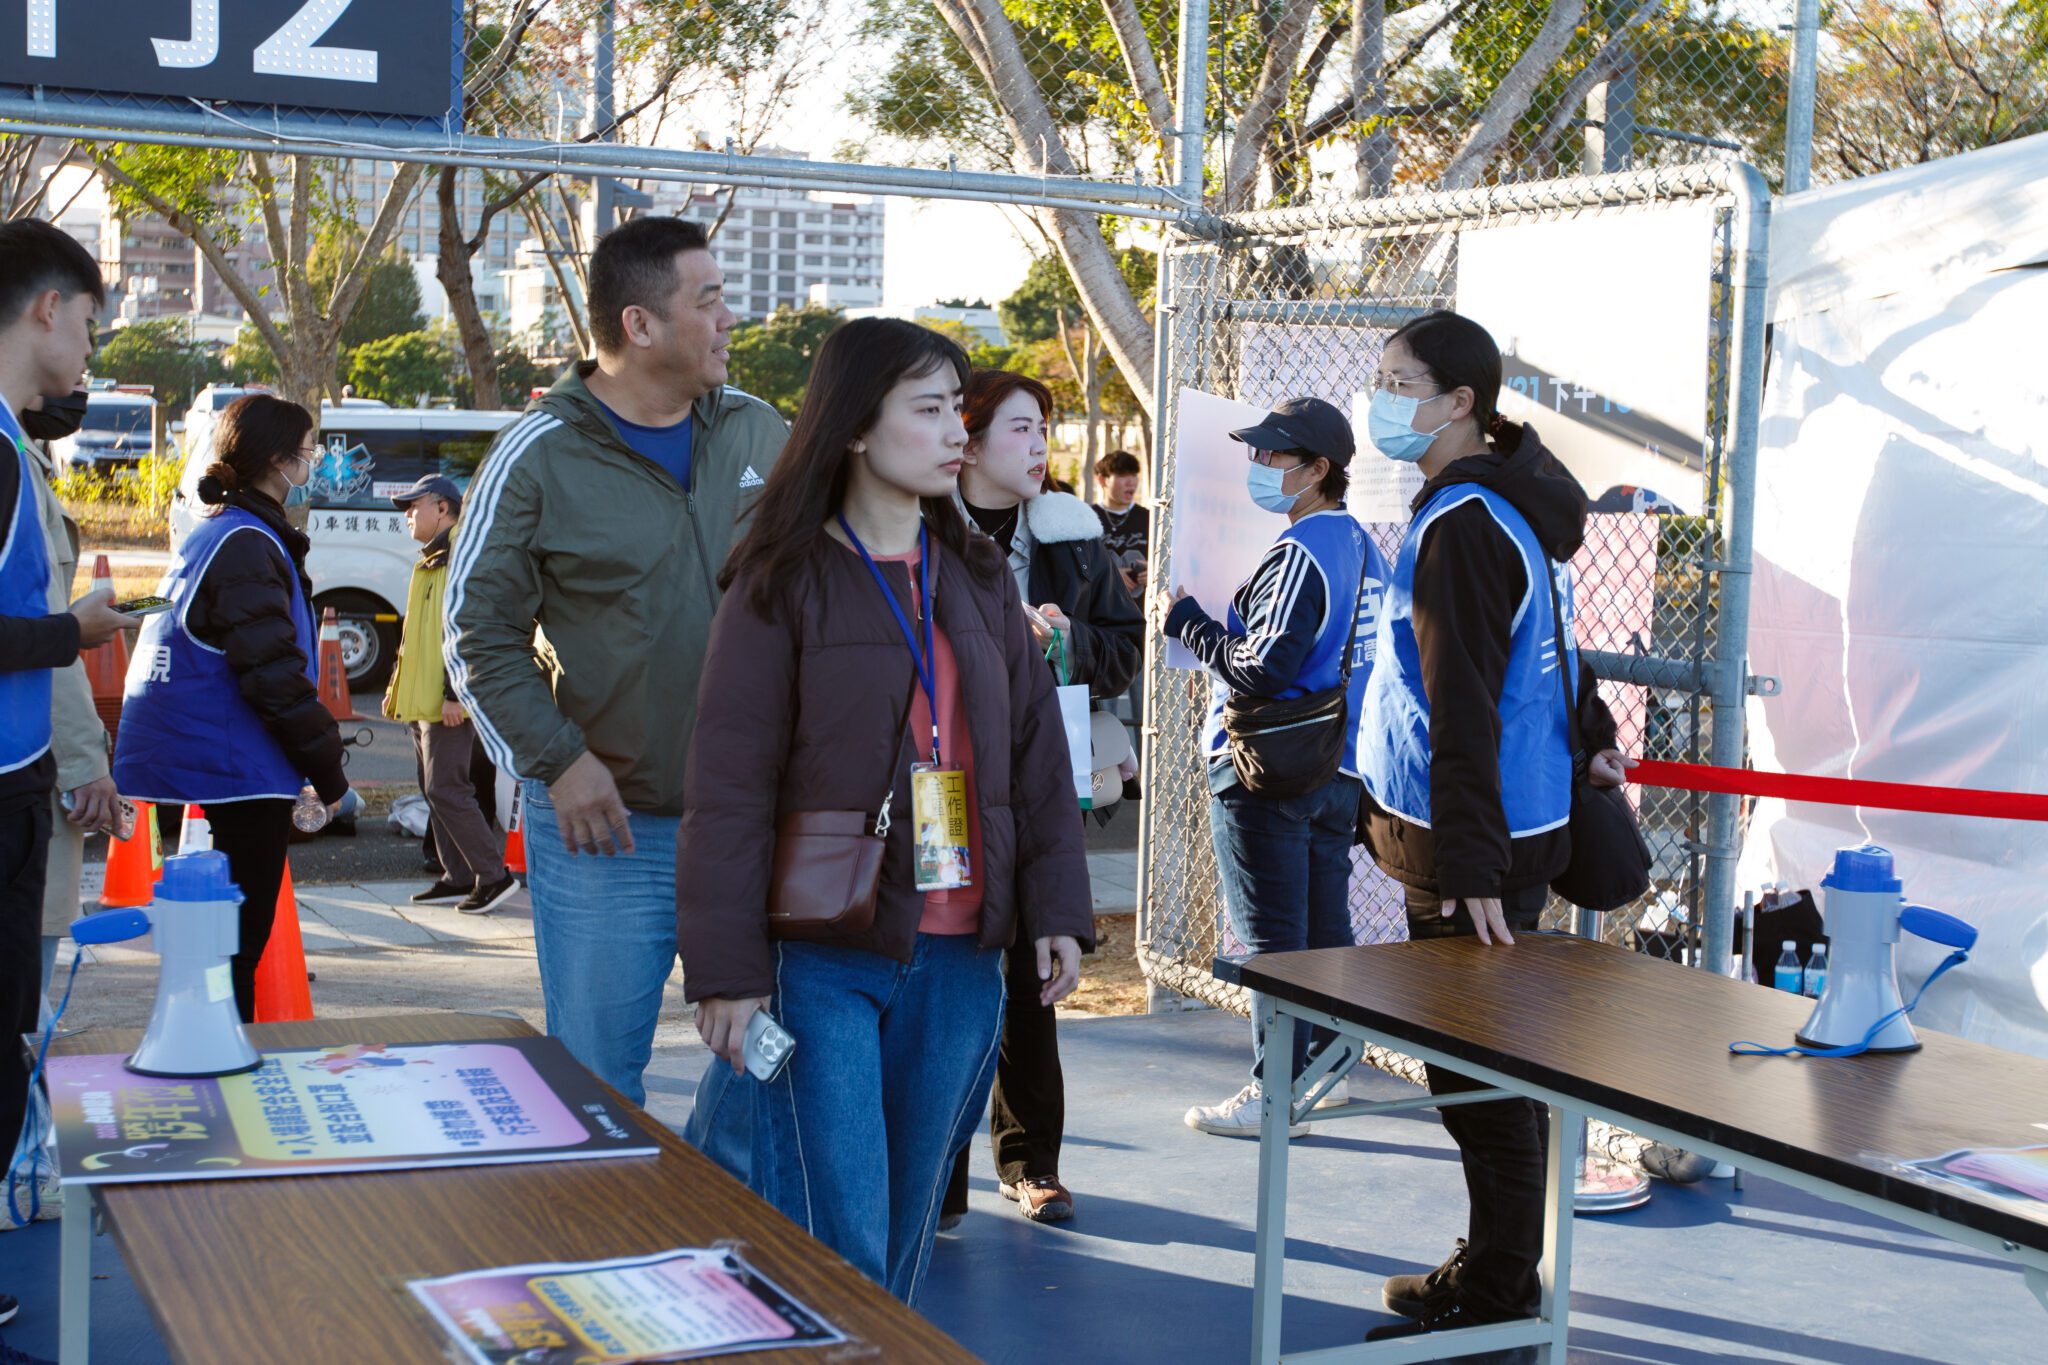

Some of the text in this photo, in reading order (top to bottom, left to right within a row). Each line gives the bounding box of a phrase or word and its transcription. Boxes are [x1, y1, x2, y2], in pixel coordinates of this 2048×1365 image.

[946, 776, 965, 837] 工作證
[119, 1084, 209, 1140] 跨年夜
[306, 1083, 375, 1145] 並配合脫口罩
